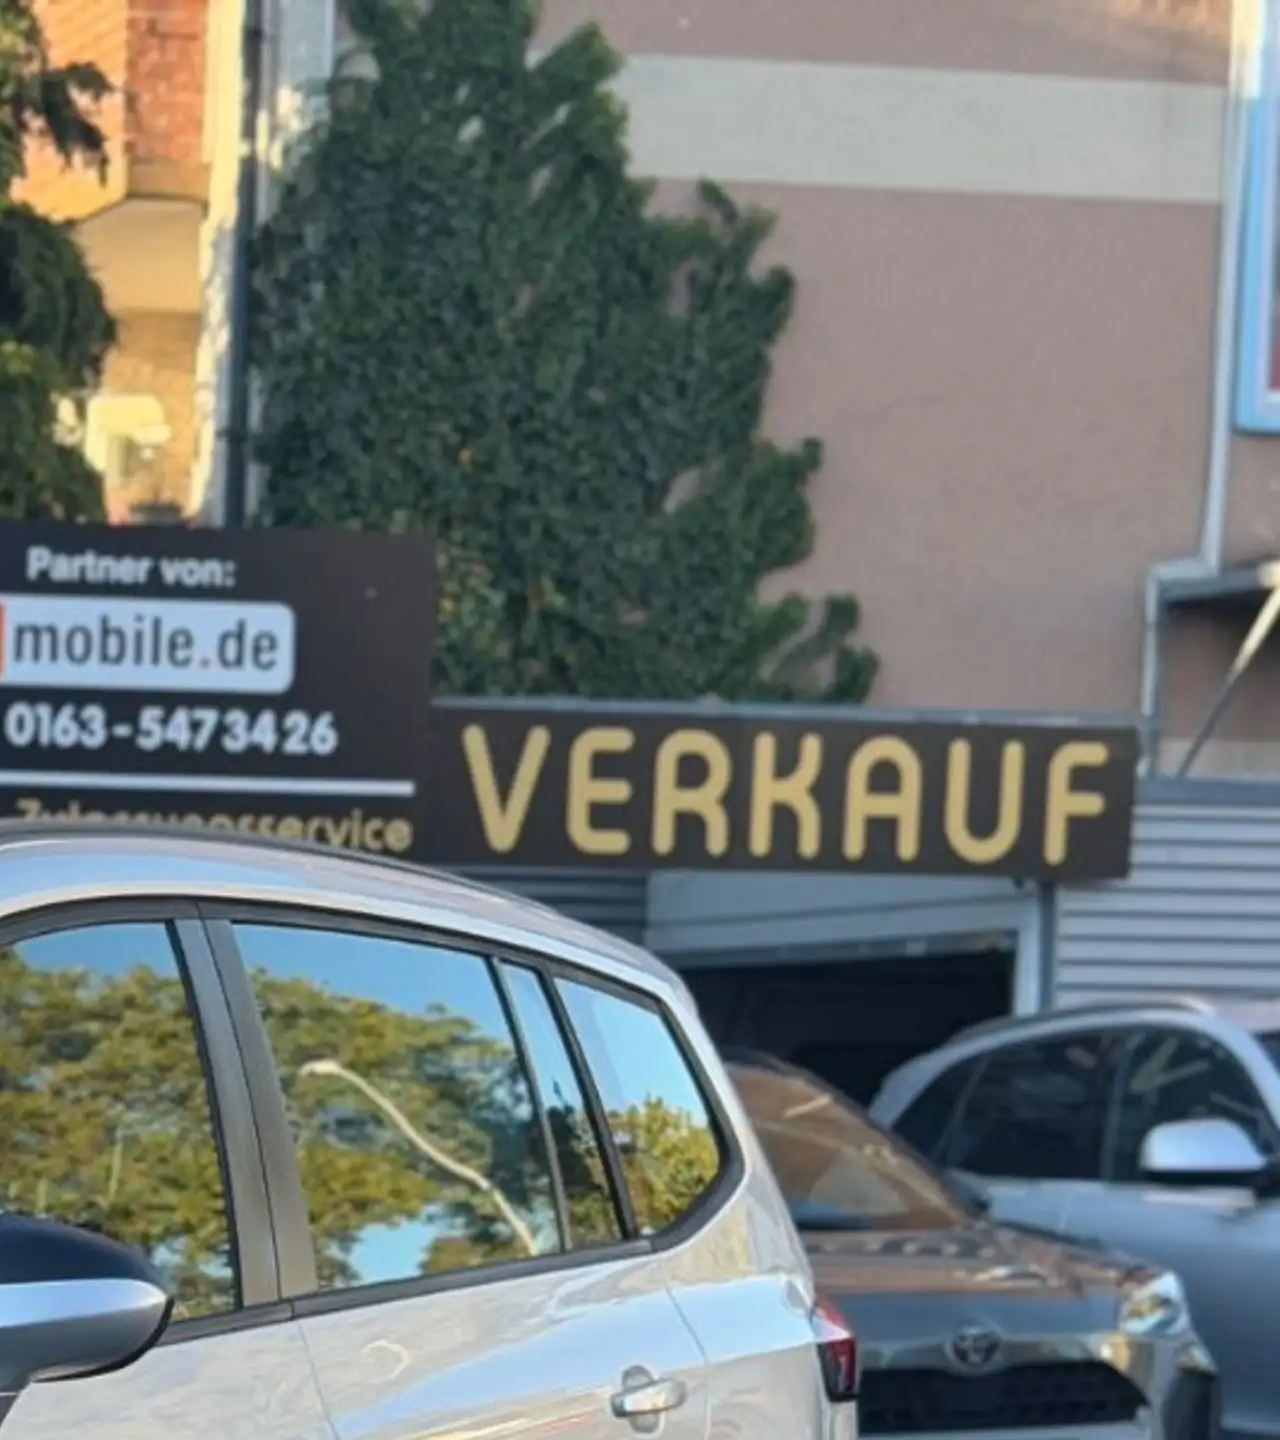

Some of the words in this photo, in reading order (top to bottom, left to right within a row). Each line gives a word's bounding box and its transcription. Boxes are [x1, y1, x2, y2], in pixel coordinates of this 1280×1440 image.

[26, 546, 151, 584] Partner
[160, 555, 237, 586] von:
[13, 614, 279, 671] mobile.de
[462, 724, 1109, 866] VERKAUF
